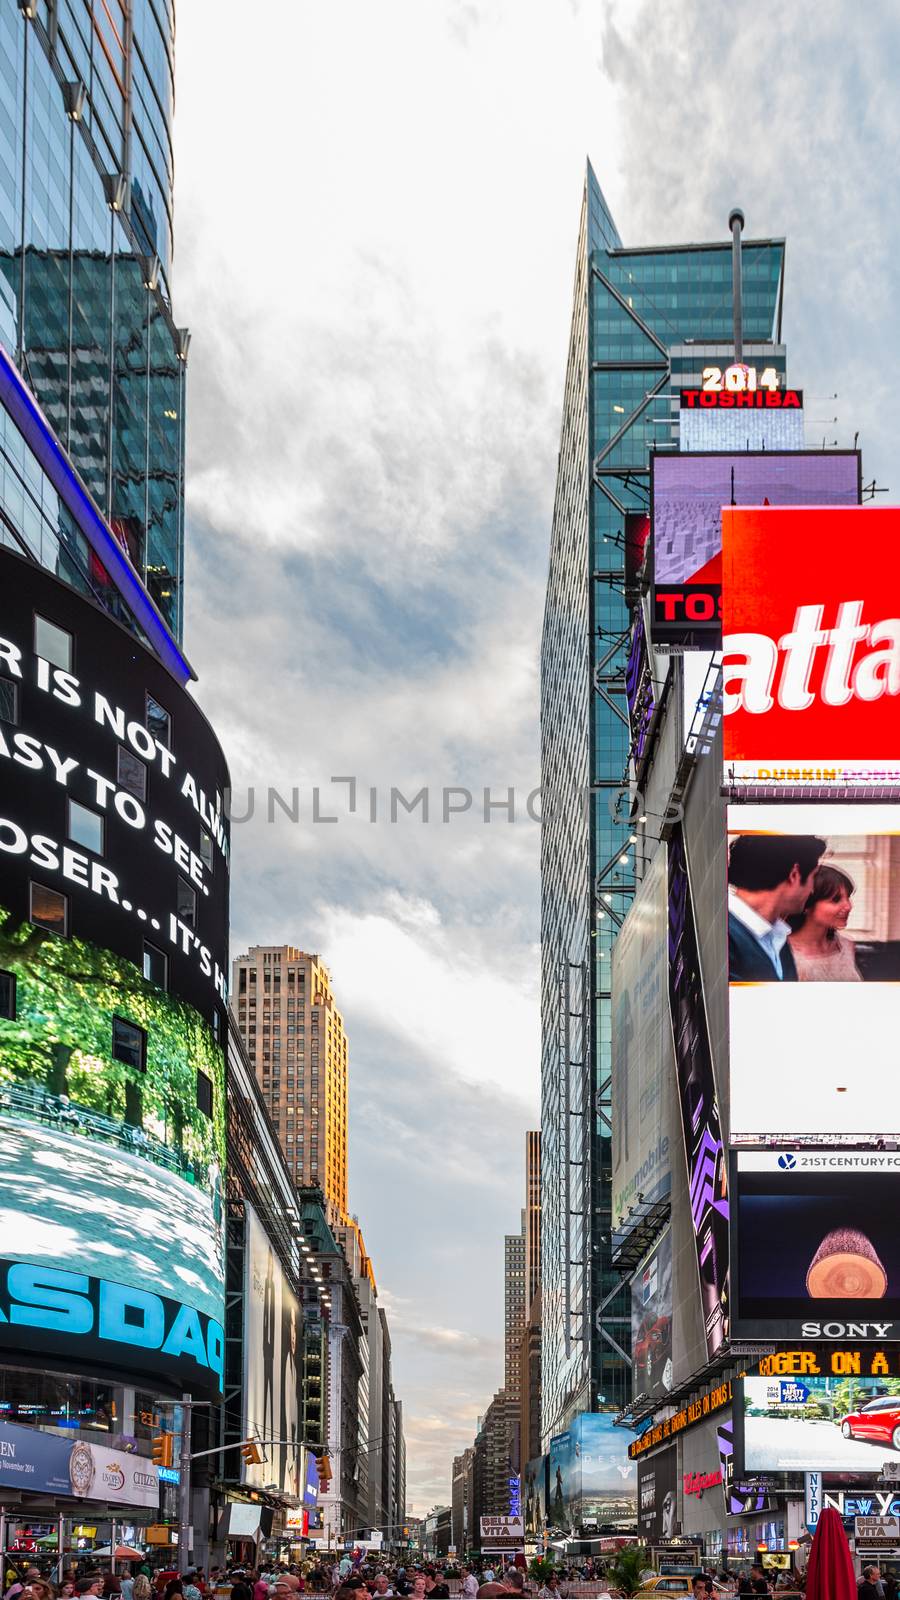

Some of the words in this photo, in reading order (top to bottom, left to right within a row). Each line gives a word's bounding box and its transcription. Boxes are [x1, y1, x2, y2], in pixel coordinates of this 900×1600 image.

[703, 368, 779, 391] 2014
[683, 391, 800, 408] TOSHIBA
[656, 593, 722, 621] TO
[37, 657, 81, 707] IS
[95, 692, 176, 778] NOT
[757, 769, 842, 780] DUNKIN'
[87, 769, 146, 829] TO
[154, 820, 209, 896] SEE.
[169, 913, 212, 976] IT'S
[801, 1157, 827, 1166] 21ST
[829, 1157, 885, 1166] CENTURY
[0, 1263, 224, 1394] SDAQ
[801, 1322, 893, 1338] SONY
[831, 1352, 861, 1374] ON
[871, 1352, 889, 1374] A
[3, 1460, 24, 1471] November
[25, 1463, 35, 1473] 2014
[134, 1472, 158, 1487] CITIZEN
[810, 1474, 818, 1523] NYPD
[482, 1517, 521, 1526] BELLA
[857, 1518, 896, 1526] BELLA
[483, 1527, 510, 1535] VITA
[857, 1527, 885, 1536] VITA
